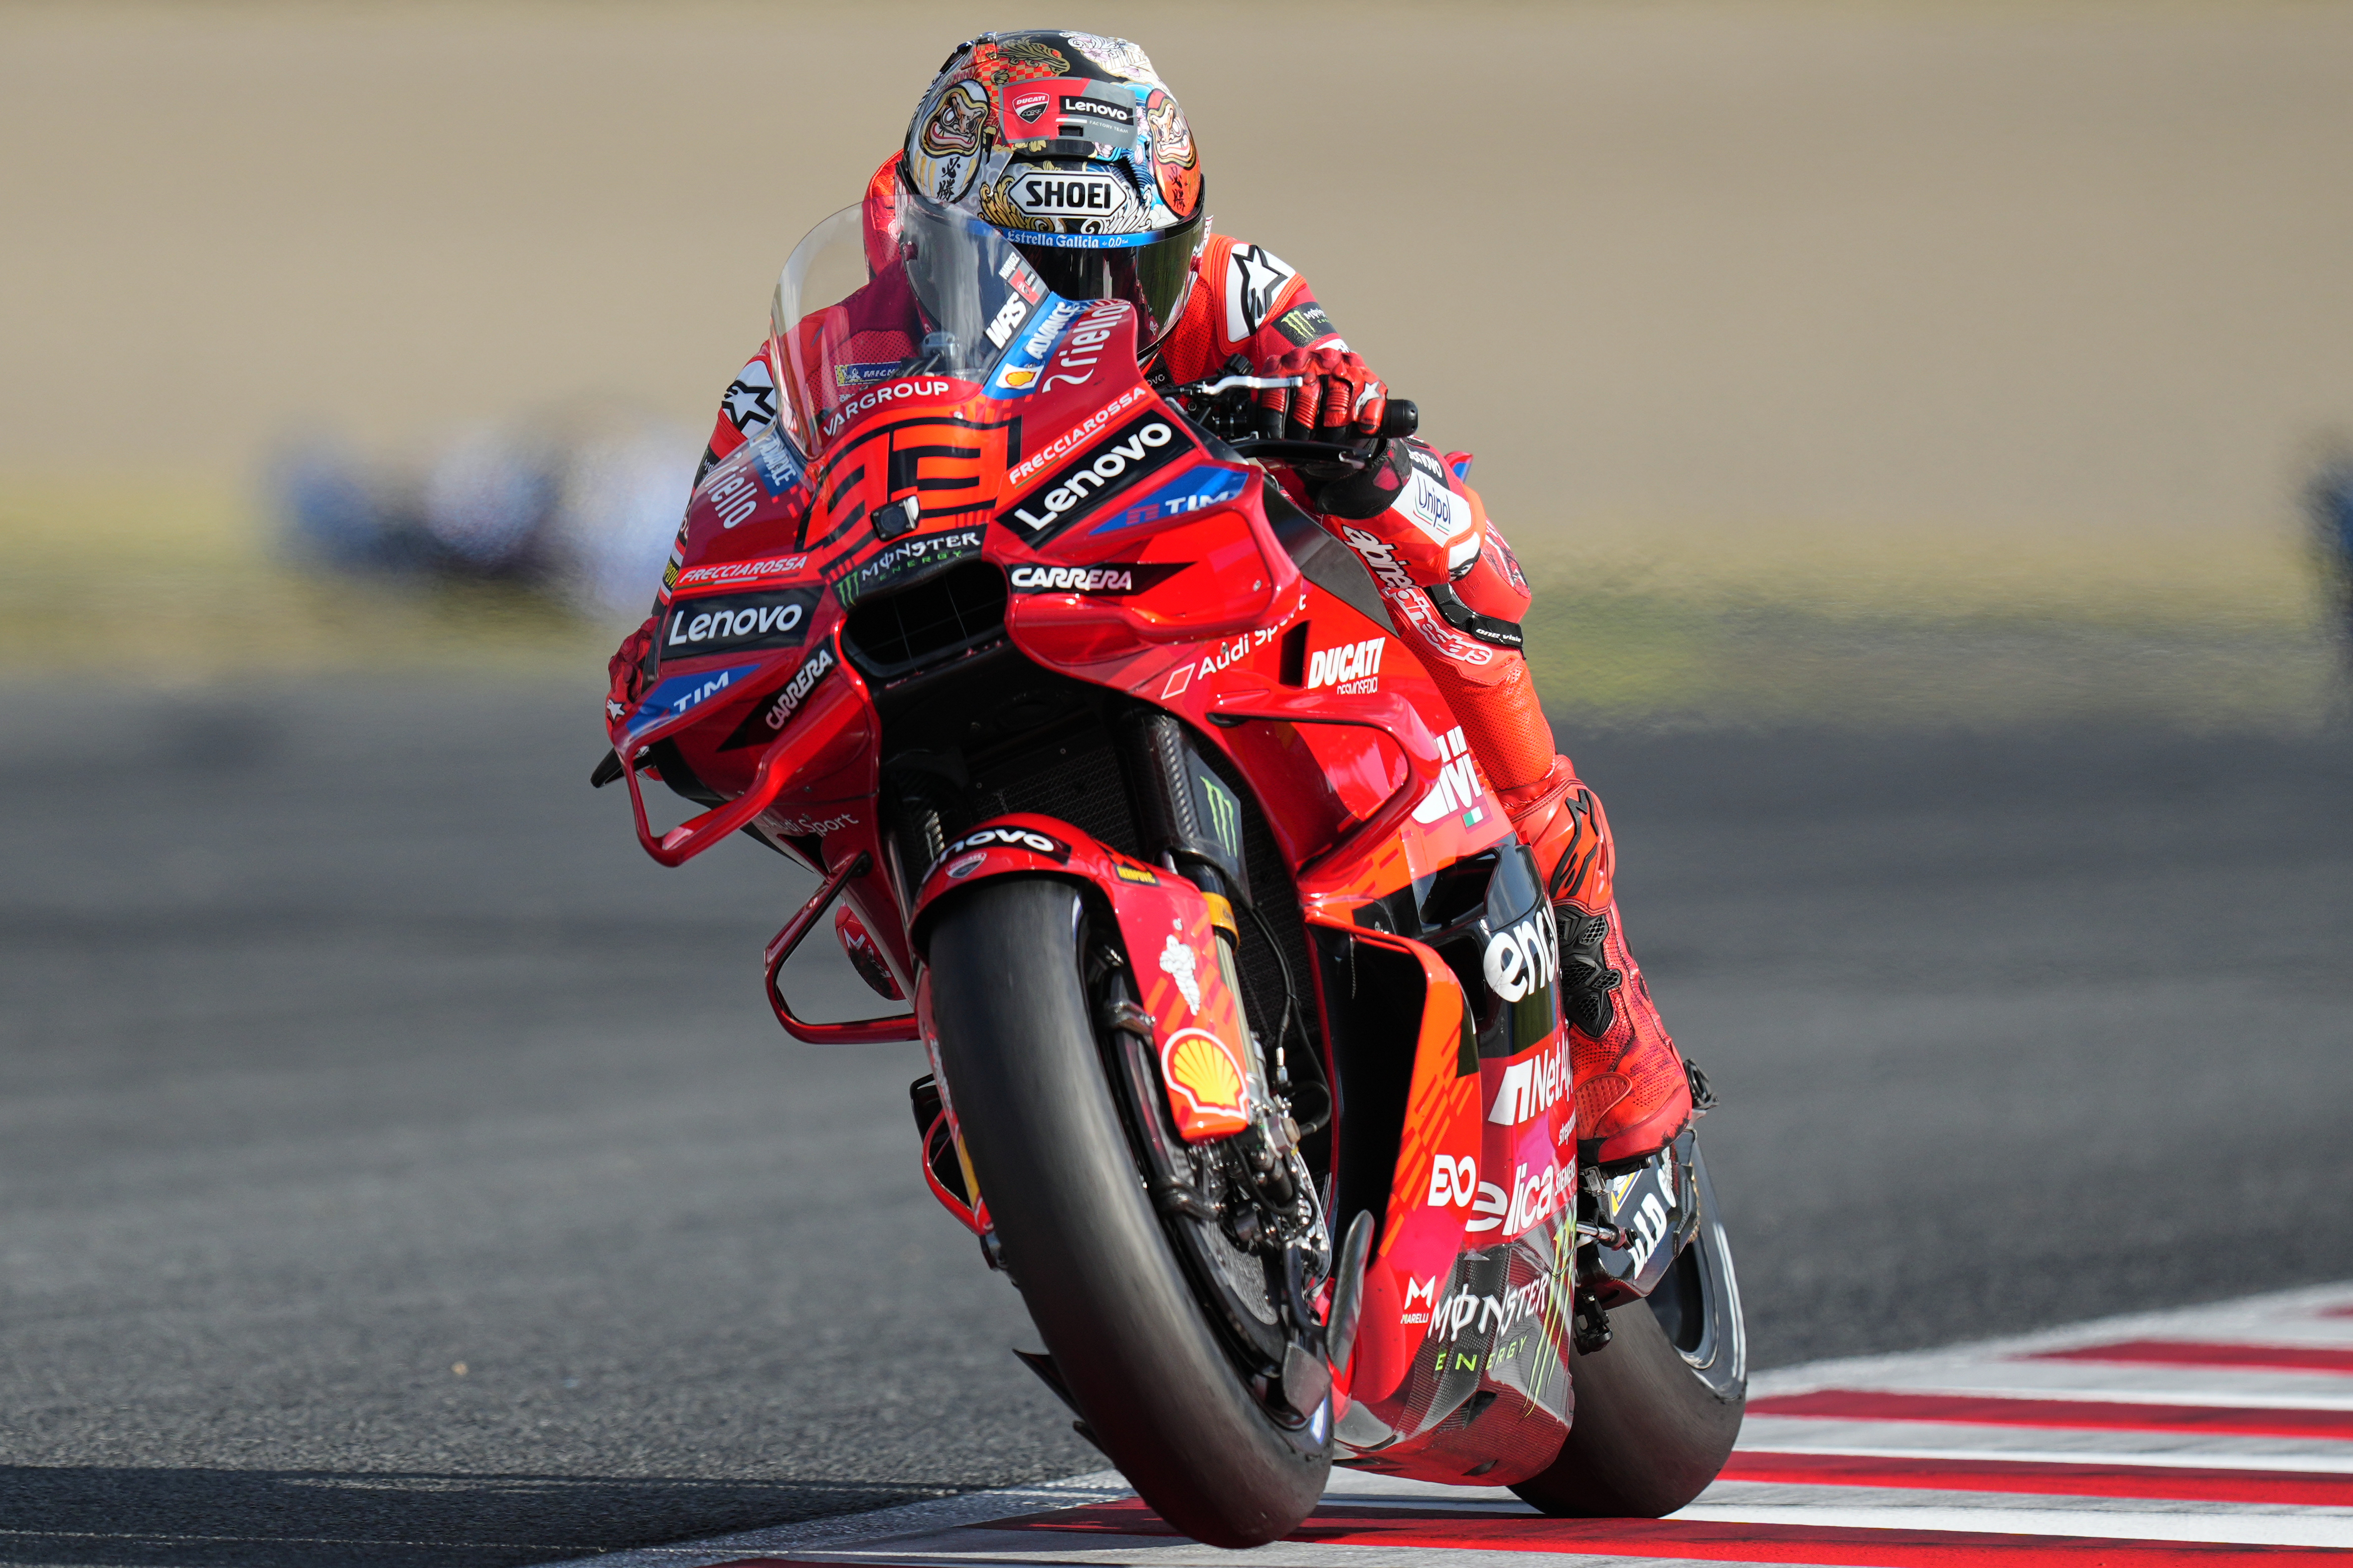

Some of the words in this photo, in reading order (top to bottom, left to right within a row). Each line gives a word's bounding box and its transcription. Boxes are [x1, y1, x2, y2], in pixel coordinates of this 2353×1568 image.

[1016, 95, 1046, 105] DUCATI
[1065, 98, 1128, 120] Lenovo
[1089, 120, 1113, 129] FACTORY
[1025, 181, 1111, 209] SHOEI
[1007, 229, 1054, 246] Estrella
[1055, 235, 1100, 248] Galicia
[998, 252, 1020, 280] MARQUEZ
[986, 291, 1027, 350] WRS
[1025, 301, 1080, 360] ADVANCE
[1058, 303, 1131, 368] riello
[823, 381, 950, 436] VARGROUP
[1008, 387, 1147, 484] FRECCIAROSSA
[704, 465, 758, 529] riello
[1014, 422, 1172, 531] Lenovo
[1165, 490, 1229, 514] TIM
[1416, 474, 1451, 528] Unipol
[679, 556, 808, 584] FRECCIAROSSA
[861, 531, 982, 582] MONSTER
[879, 549, 963, 581] ENERGY
[1011, 567, 1132, 591] CARRERA
[669, 603, 803, 646] Lenovo
[1197, 633, 1249, 680] Audi
[1307, 637, 1386, 689] DUCATI
[674, 671, 729, 713] TIM
[765, 649, 833, 731] CARRERA
[798, 812, 859, 837] Sport
[1465, 1162, 1554, 1236] elica
[1400, 1312, 1429, 1324] MARELLI
[1428, 1272, 1550, 1344] MONSTER
[1435, 1335, 1527, 1372] ENERGY
